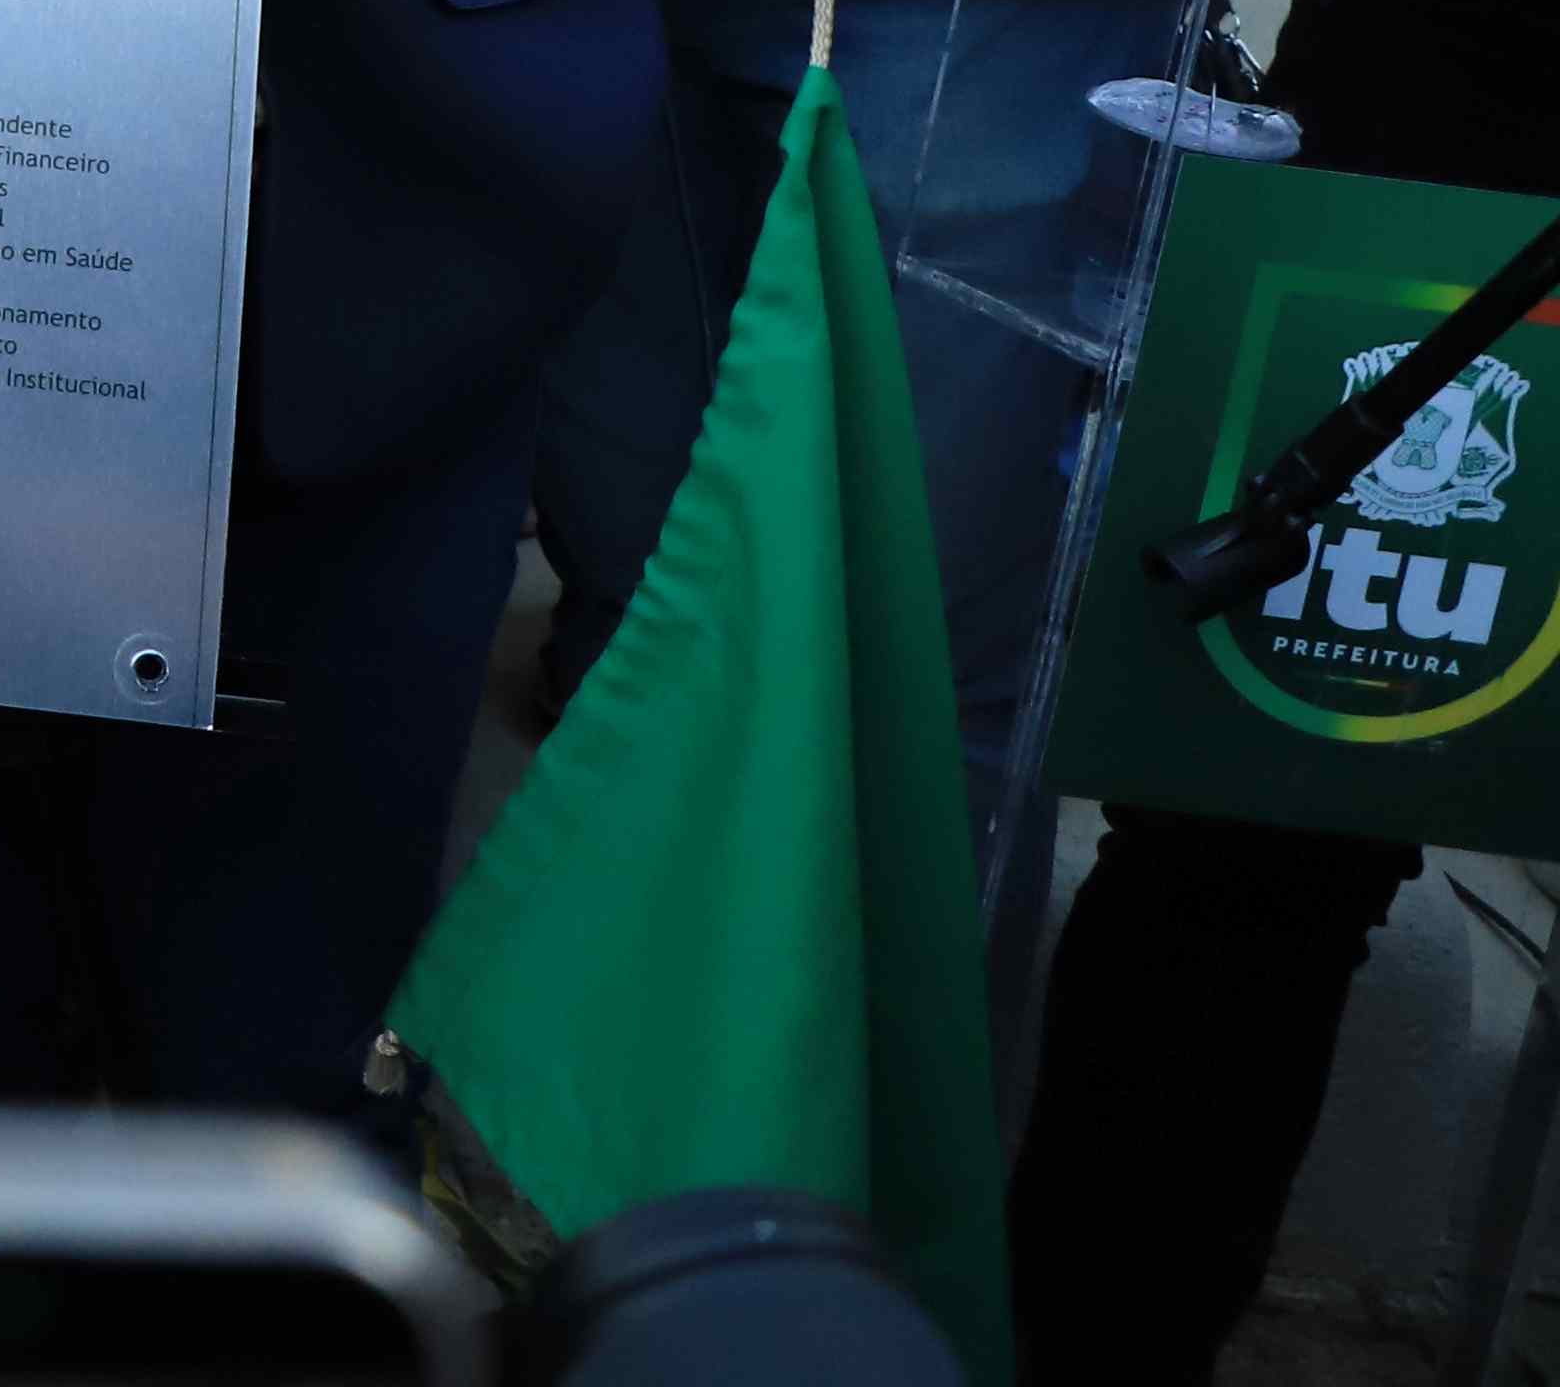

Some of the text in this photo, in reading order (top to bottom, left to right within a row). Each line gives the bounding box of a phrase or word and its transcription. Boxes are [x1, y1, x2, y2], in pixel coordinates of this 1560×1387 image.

[20, 246, 58, 266] em
[64, 245, 134, 274] Saúde
[5, 365, 147, 402] Institucional
[1272, 636, 1460, 676] PREFEITURA
